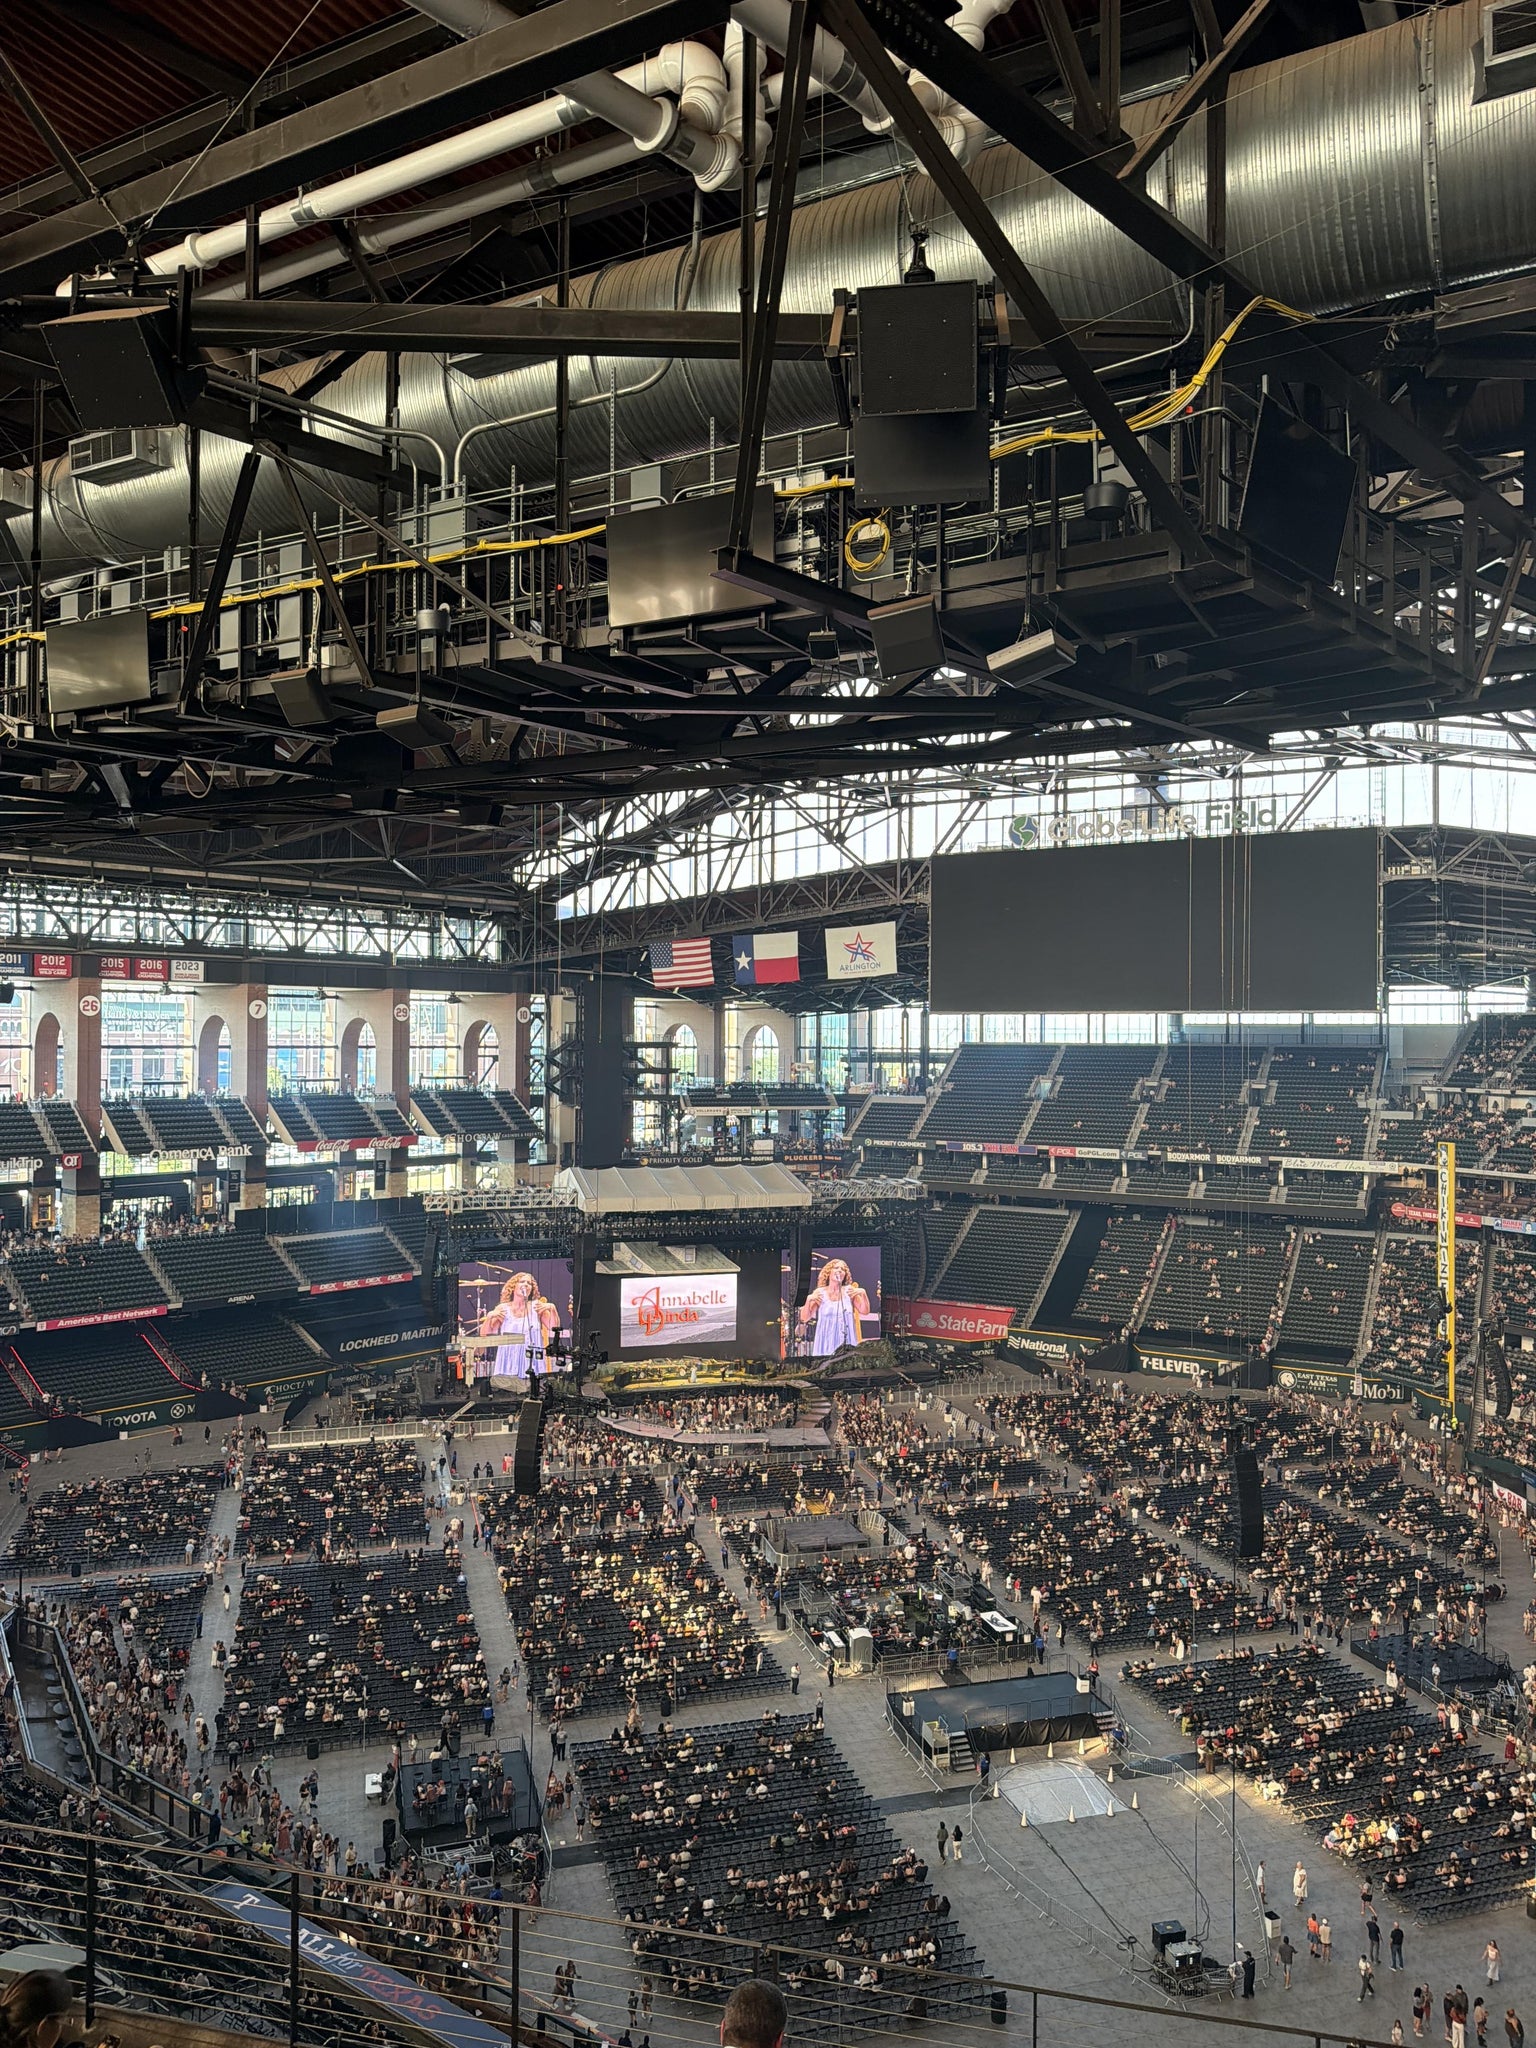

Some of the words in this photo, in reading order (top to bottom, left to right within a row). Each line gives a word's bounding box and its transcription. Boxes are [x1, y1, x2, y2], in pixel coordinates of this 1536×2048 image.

[1048, 814, 1133, 842] Globe
[1140, 806, 1197, 834] Life
[1205, 799, 1277, 831] Field
[0, 954, 22, 964] 2011
[41, 955, 66, 966] 2012
[101, 958, 124, 968] 2015
[140, 959, 163, 970] 2016
[175, 960, 200, 971] 2023
[840, 962, 881, 972] ARLINGTON
[82, 1000, 98, 1012] 26
[254, 1004, 262, 1014] 7
[395, 1007, 408, 1018] 29
[519, 1010, 528, 1020] 10
[217, 1144, 253, 1157] Bank
[962, 1143, 983, 1151] 105.3
[1057, 1148, 1074, 1156] PGL
[1078, 1150, 1117, 1159] GoPGL.com
[1127, 1151, 1143, 1159] PGL
[1167, 1153, 1211, 1161] BODYARMOR
[1217, 1155, 1262, 1164] BODYARMOR
[0, 1156, 43, 1171] uikTrip
[64, 1156, 79, 1167] QT
[1439, 1171, 1449, 1244] CHIKIN
[227, 1294, 256, 1303] ARENA
[632, 1287, 727, 1319] Annabelle
[57, 1315, 101, 1327] America's
[103, 1313, 121, 1321] Best
[123, 1308, 158, 1318] Network
[339, 1333, 399, 1352] LOCKHEED
[401, 1326, 443, 1342] MARTIN
[1020, 1338, 1067, 1354] National
[1297, 1372, 1315, 1380] EAST
[1315, 1374, 1338, 1383] TEXAS
[270, 1379, 315, 1394] CHOCTW
[1308, 1379, 1327, 1388] A&M
[106, 1411, 157, 1429] TOYOTA
[1507, 1491, 1523, 1509] BAR
[360, 1965, 443, 2020] TEXAS
